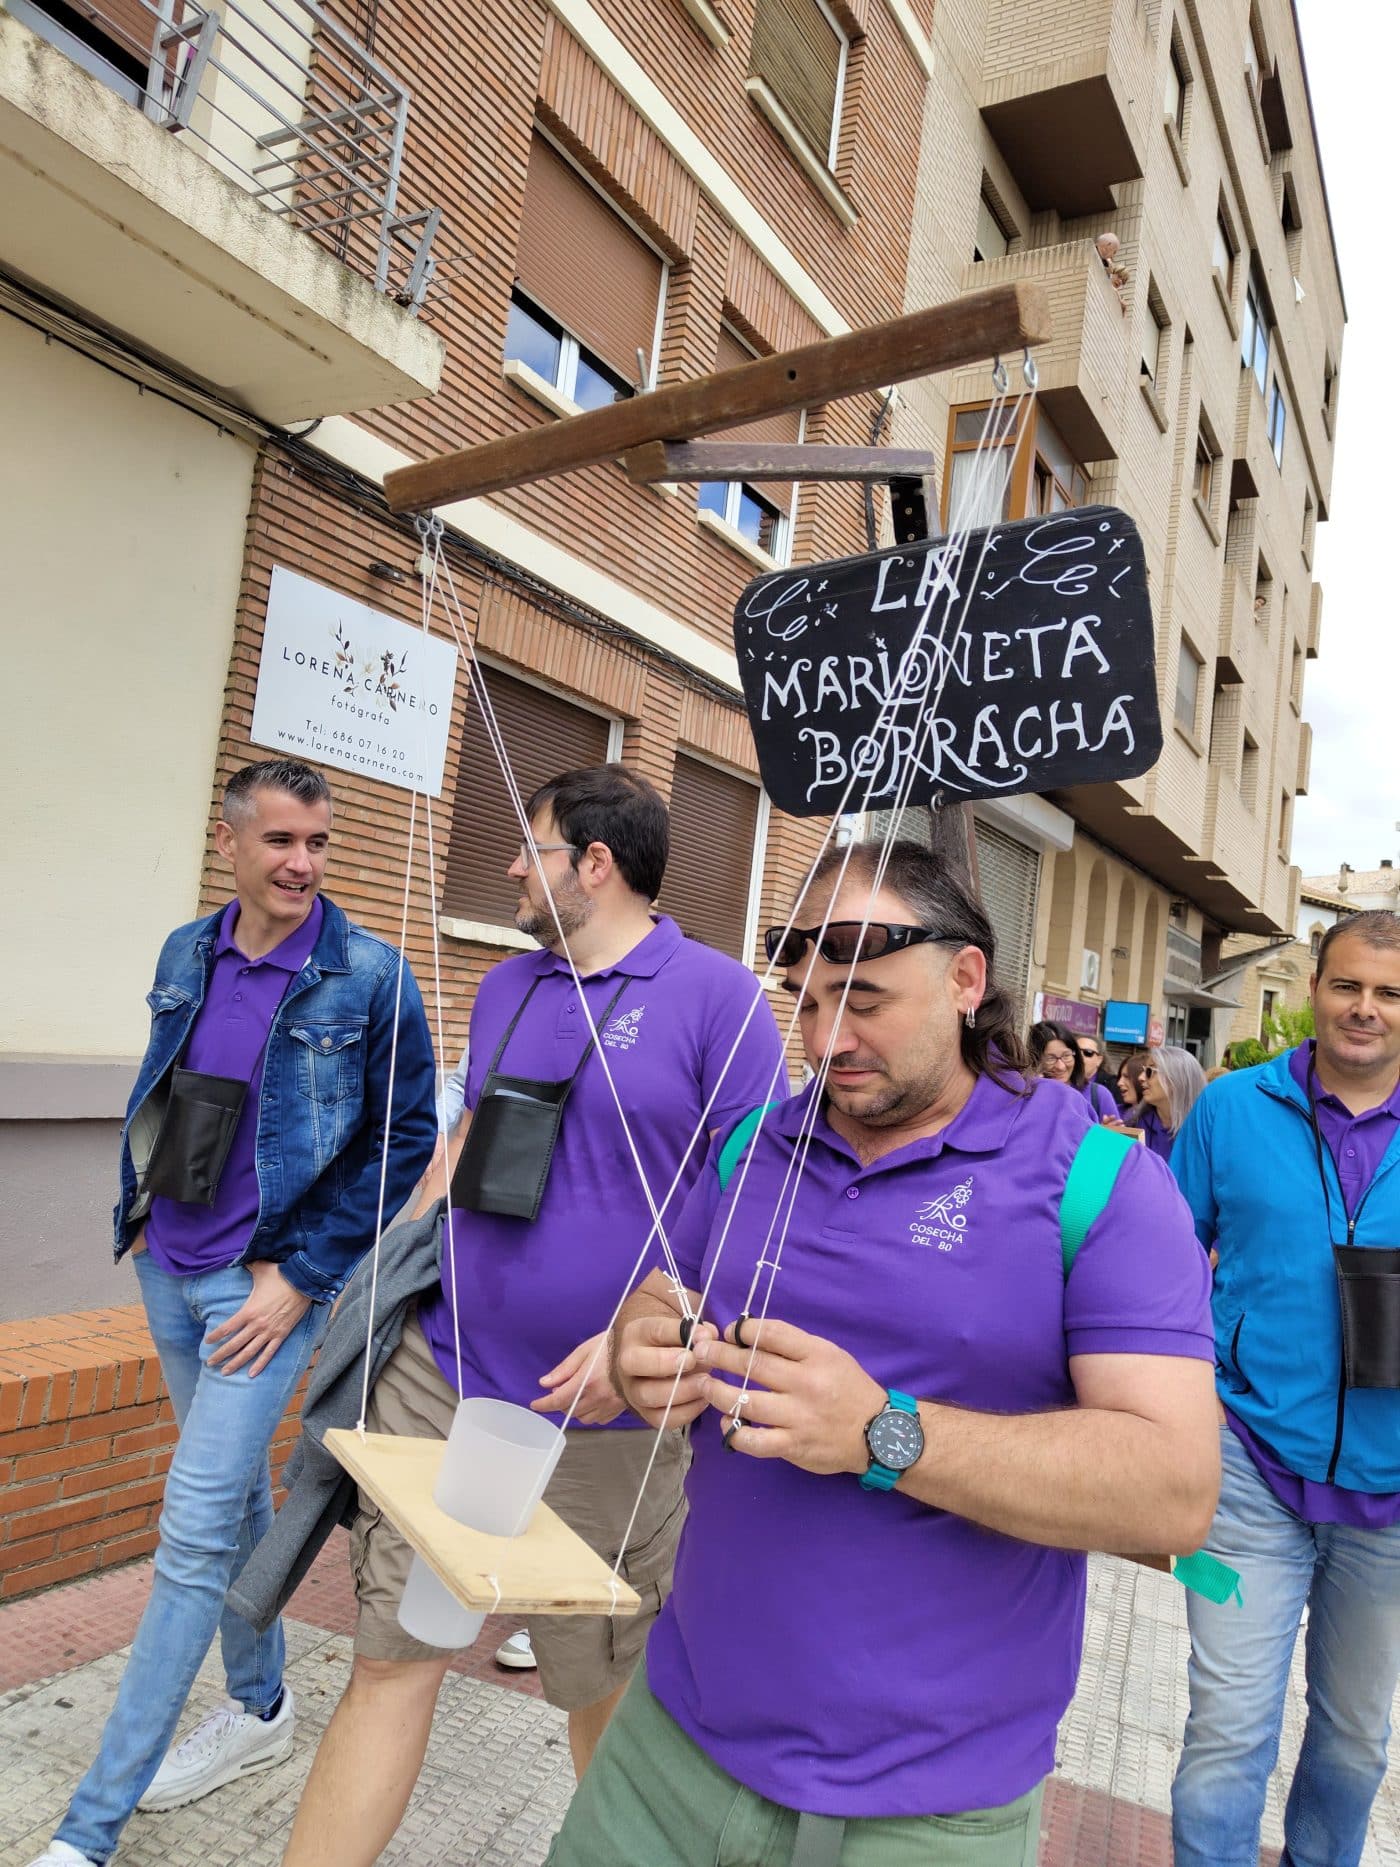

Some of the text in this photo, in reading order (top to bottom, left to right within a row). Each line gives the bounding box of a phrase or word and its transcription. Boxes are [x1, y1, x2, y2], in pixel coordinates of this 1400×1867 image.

[870, 544, 961, 613] LA
[283, 646, 438, 716] LORENA CARNEO
[761, 614, 1111, 720] MARIONETA
[331, 694, 390, 725] fotógrafa
[278, 730, 424, 782] www.lorenacarnero.com
[332, 730, 353, 744] 686
[358, 738, 372, 750] 07
[377, 744, 387, 755] 16
[392, 749, 405, 761] 20
[799, 694, 1136, 803] BORRACHA
[909, 1223, 962, 1243] COSECHA
[911, 1235, 952, 1251] DEL 80
